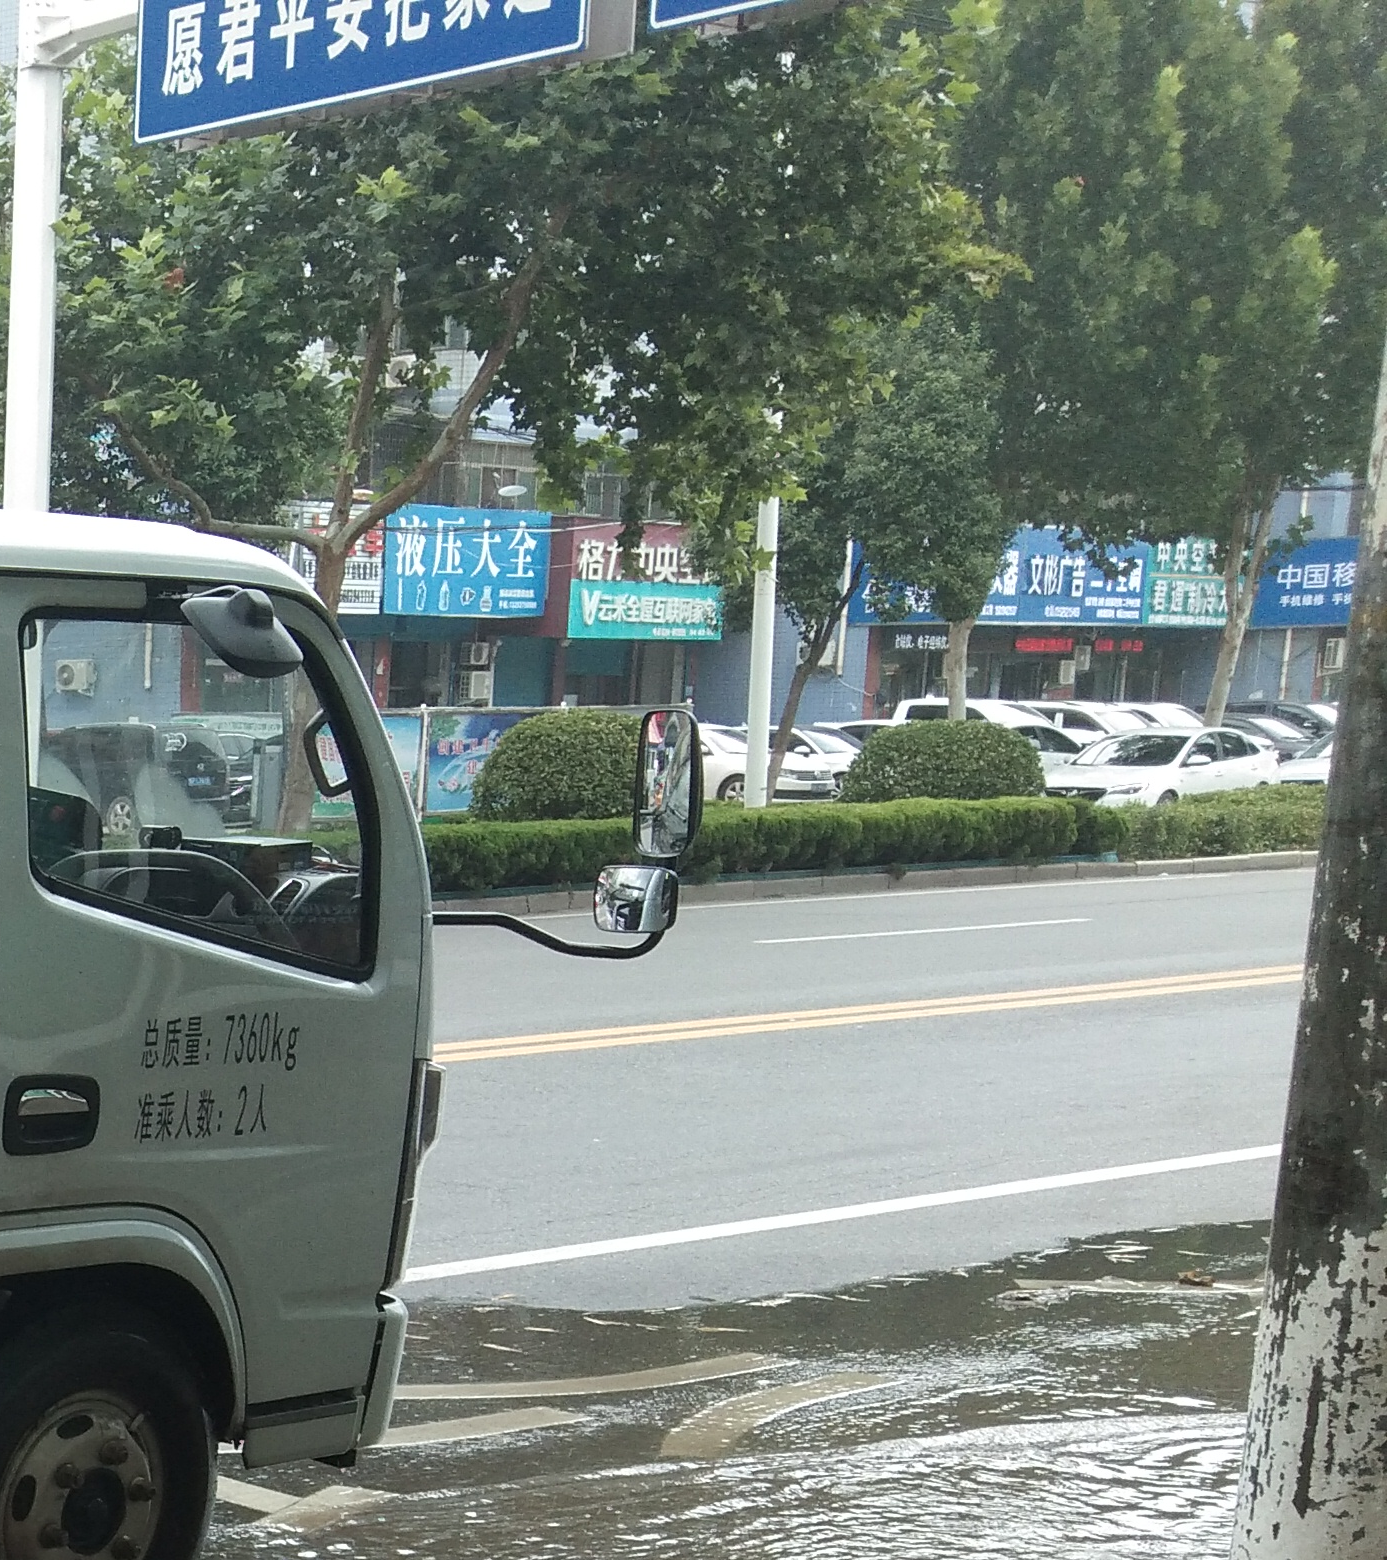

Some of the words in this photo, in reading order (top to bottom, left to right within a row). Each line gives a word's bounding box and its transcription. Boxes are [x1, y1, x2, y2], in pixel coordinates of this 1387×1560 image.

[396, 515, 537, 578] 液压大全
[1028, 555, 1085, 597] 文彬广告
[134, 1084, 267, 1144] 准乘人数：2人
